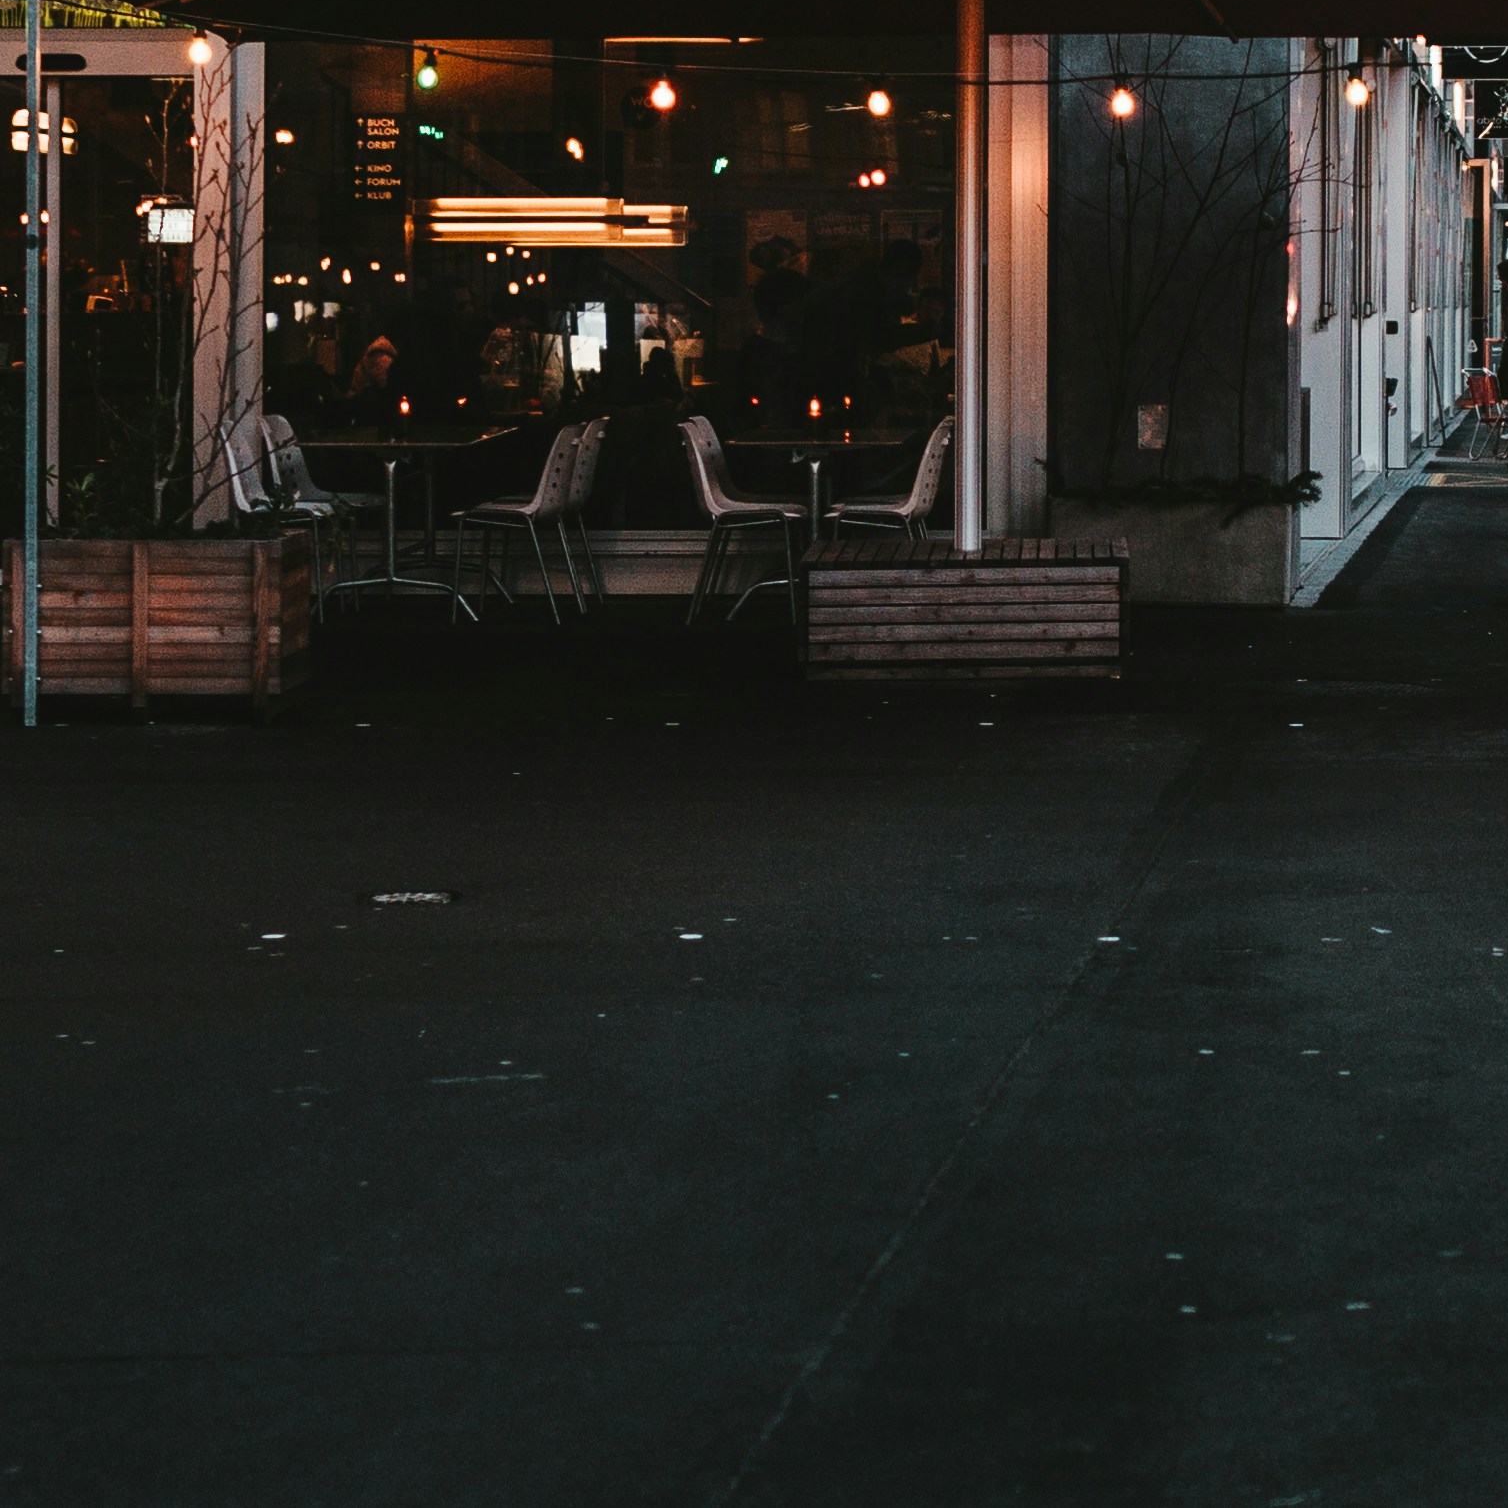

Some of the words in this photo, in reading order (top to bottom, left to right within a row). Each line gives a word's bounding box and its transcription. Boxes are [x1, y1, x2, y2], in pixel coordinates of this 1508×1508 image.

[367, 118, 395, 126] BUCH
[367, 128, 399, 136] SALON
[367, 141, 396, 149] ORBIT
[367, 164, 392, 172] KINO
[367, 178, 401, 186] FORUM
[367, 191, 392, 199] KLUB
